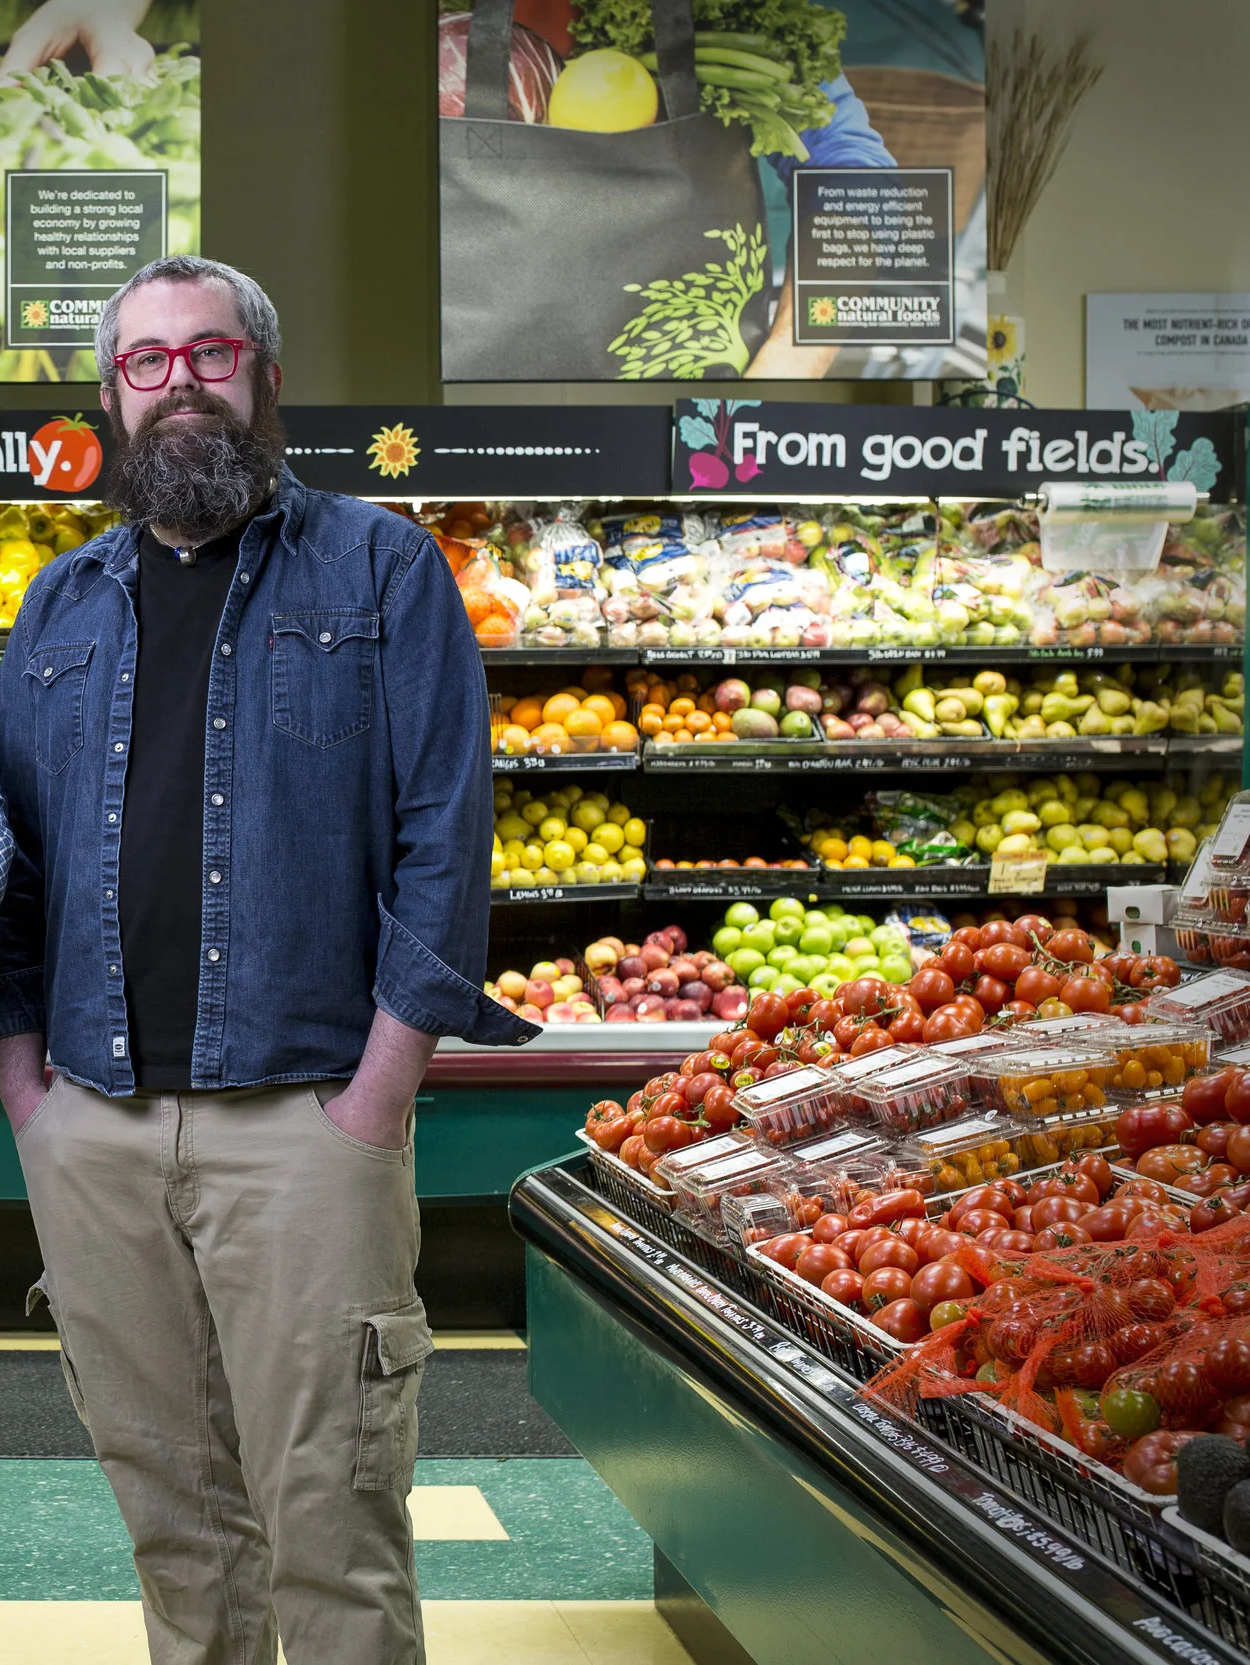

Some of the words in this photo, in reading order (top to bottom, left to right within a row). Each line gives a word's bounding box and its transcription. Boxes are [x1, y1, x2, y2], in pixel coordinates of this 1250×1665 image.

[38, 190, 67, 200] We're
[70, 190, 121, 200] dedicated
[124, 191, 135, 200] to
[818, 186, 844, 197] From
[847, 188, 878, 197] waste
[880, 187, 928, 197] reduction
[30, 204, 71, 215] building
[83, 205, 116, 216] strong
[119, 204, 143, 213] local
[823, 201, 842, 211] and
[846, 203, 880, 213] energy
[883, 201, 923, 211] efficient
[33, 219, 81, 229] economy
[83, 218, 96, 229] by
[99, 218, 140, 229] growing
[814, 215, 868, 226] equipment
[871, 216, 882, 225] to
[885, 215, 913, 226] being
[916, 215, 933, 225] the
[34, 232, 71, 242] healthy
[74, 232, 139, 242] relationships
[812, 229, 831, 239] first
[834, 230, 844, 239] to
[847, 230, 869, 240] stop
[872, 229, 899, 241] using
[902, 229, 935, 239] plastic
[37, 246, 59, 255] with
[62, 246, 86, 255] local
[89, 246, 136, 256] suppliers
[823, 243, 851, 254] bags,
[853, 245, 868, 253] we
[871, 243, 896, 253] have
[898, 243, 924, 255] deep
[46, 260, 65, 269] and
[68, 260, 127, 270] non-profits.
[817, 257, 856, 268] respect
[859, 257, 873, 267] for
[875, 257, 892, 266] the
[895, 257, 929, 268] planet.
[50, 300, 106, 313] COMM
[837, 297, 940, 310] COMMUNITY
[838, 310, 892, 321] natural
[897, 309, 940, 321] foods
[1123, 319, 1139, 330] THE
[1143, 319, 1167, 330] MOST
[1171, 319, 1238, 330] NUTRIENT-RICH
[1155, 335, 1196, 346] COMPOST
[1201, 335, 1210, 345] IN
[1214, 334, 1248, 345] CANADA
[733, 422, 845, 467] From
[861, 429, 987, 480] good
[1003, 428, 1159, 473] fields.
